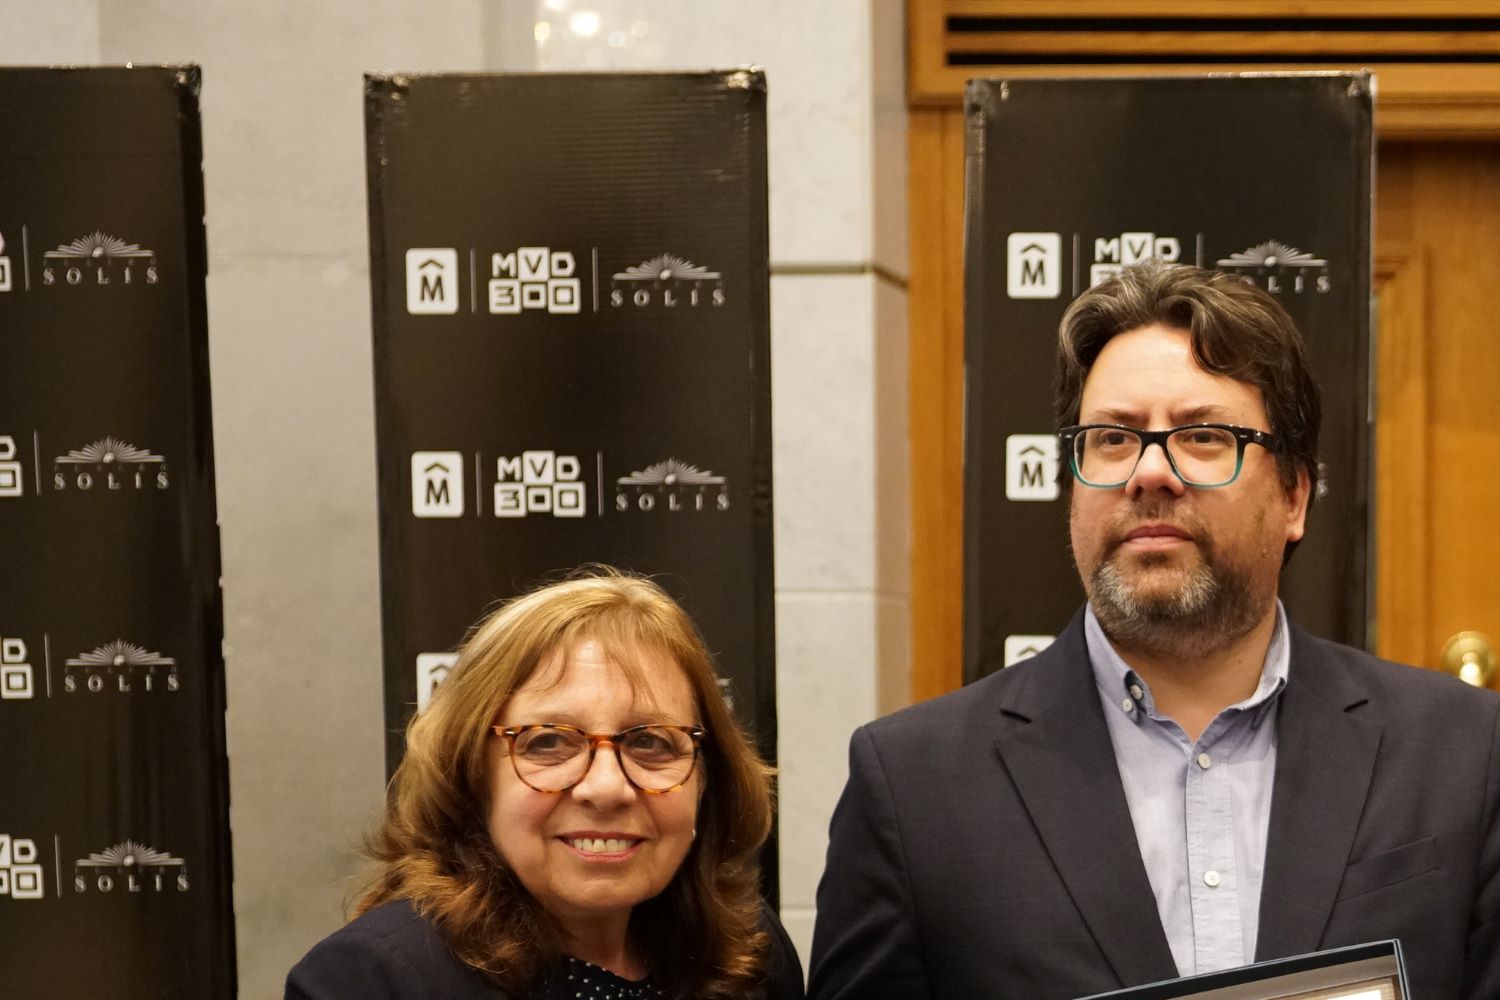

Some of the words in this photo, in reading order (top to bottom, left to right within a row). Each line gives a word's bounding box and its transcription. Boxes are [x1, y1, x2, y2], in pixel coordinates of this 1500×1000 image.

[491, 247, 576, 281] MVD
[43, 267, 160, 286] SOLIS
[610, 289, 726, 308] SOLIS
[497, 451, 582, 484] MVD
[54, 472, 171, 490] SOLIS
[615, 494, 731, 512] SOLIS
[65, 675, 181, 693] SOLIS
[75, 874, 190, 894] SOLIS
